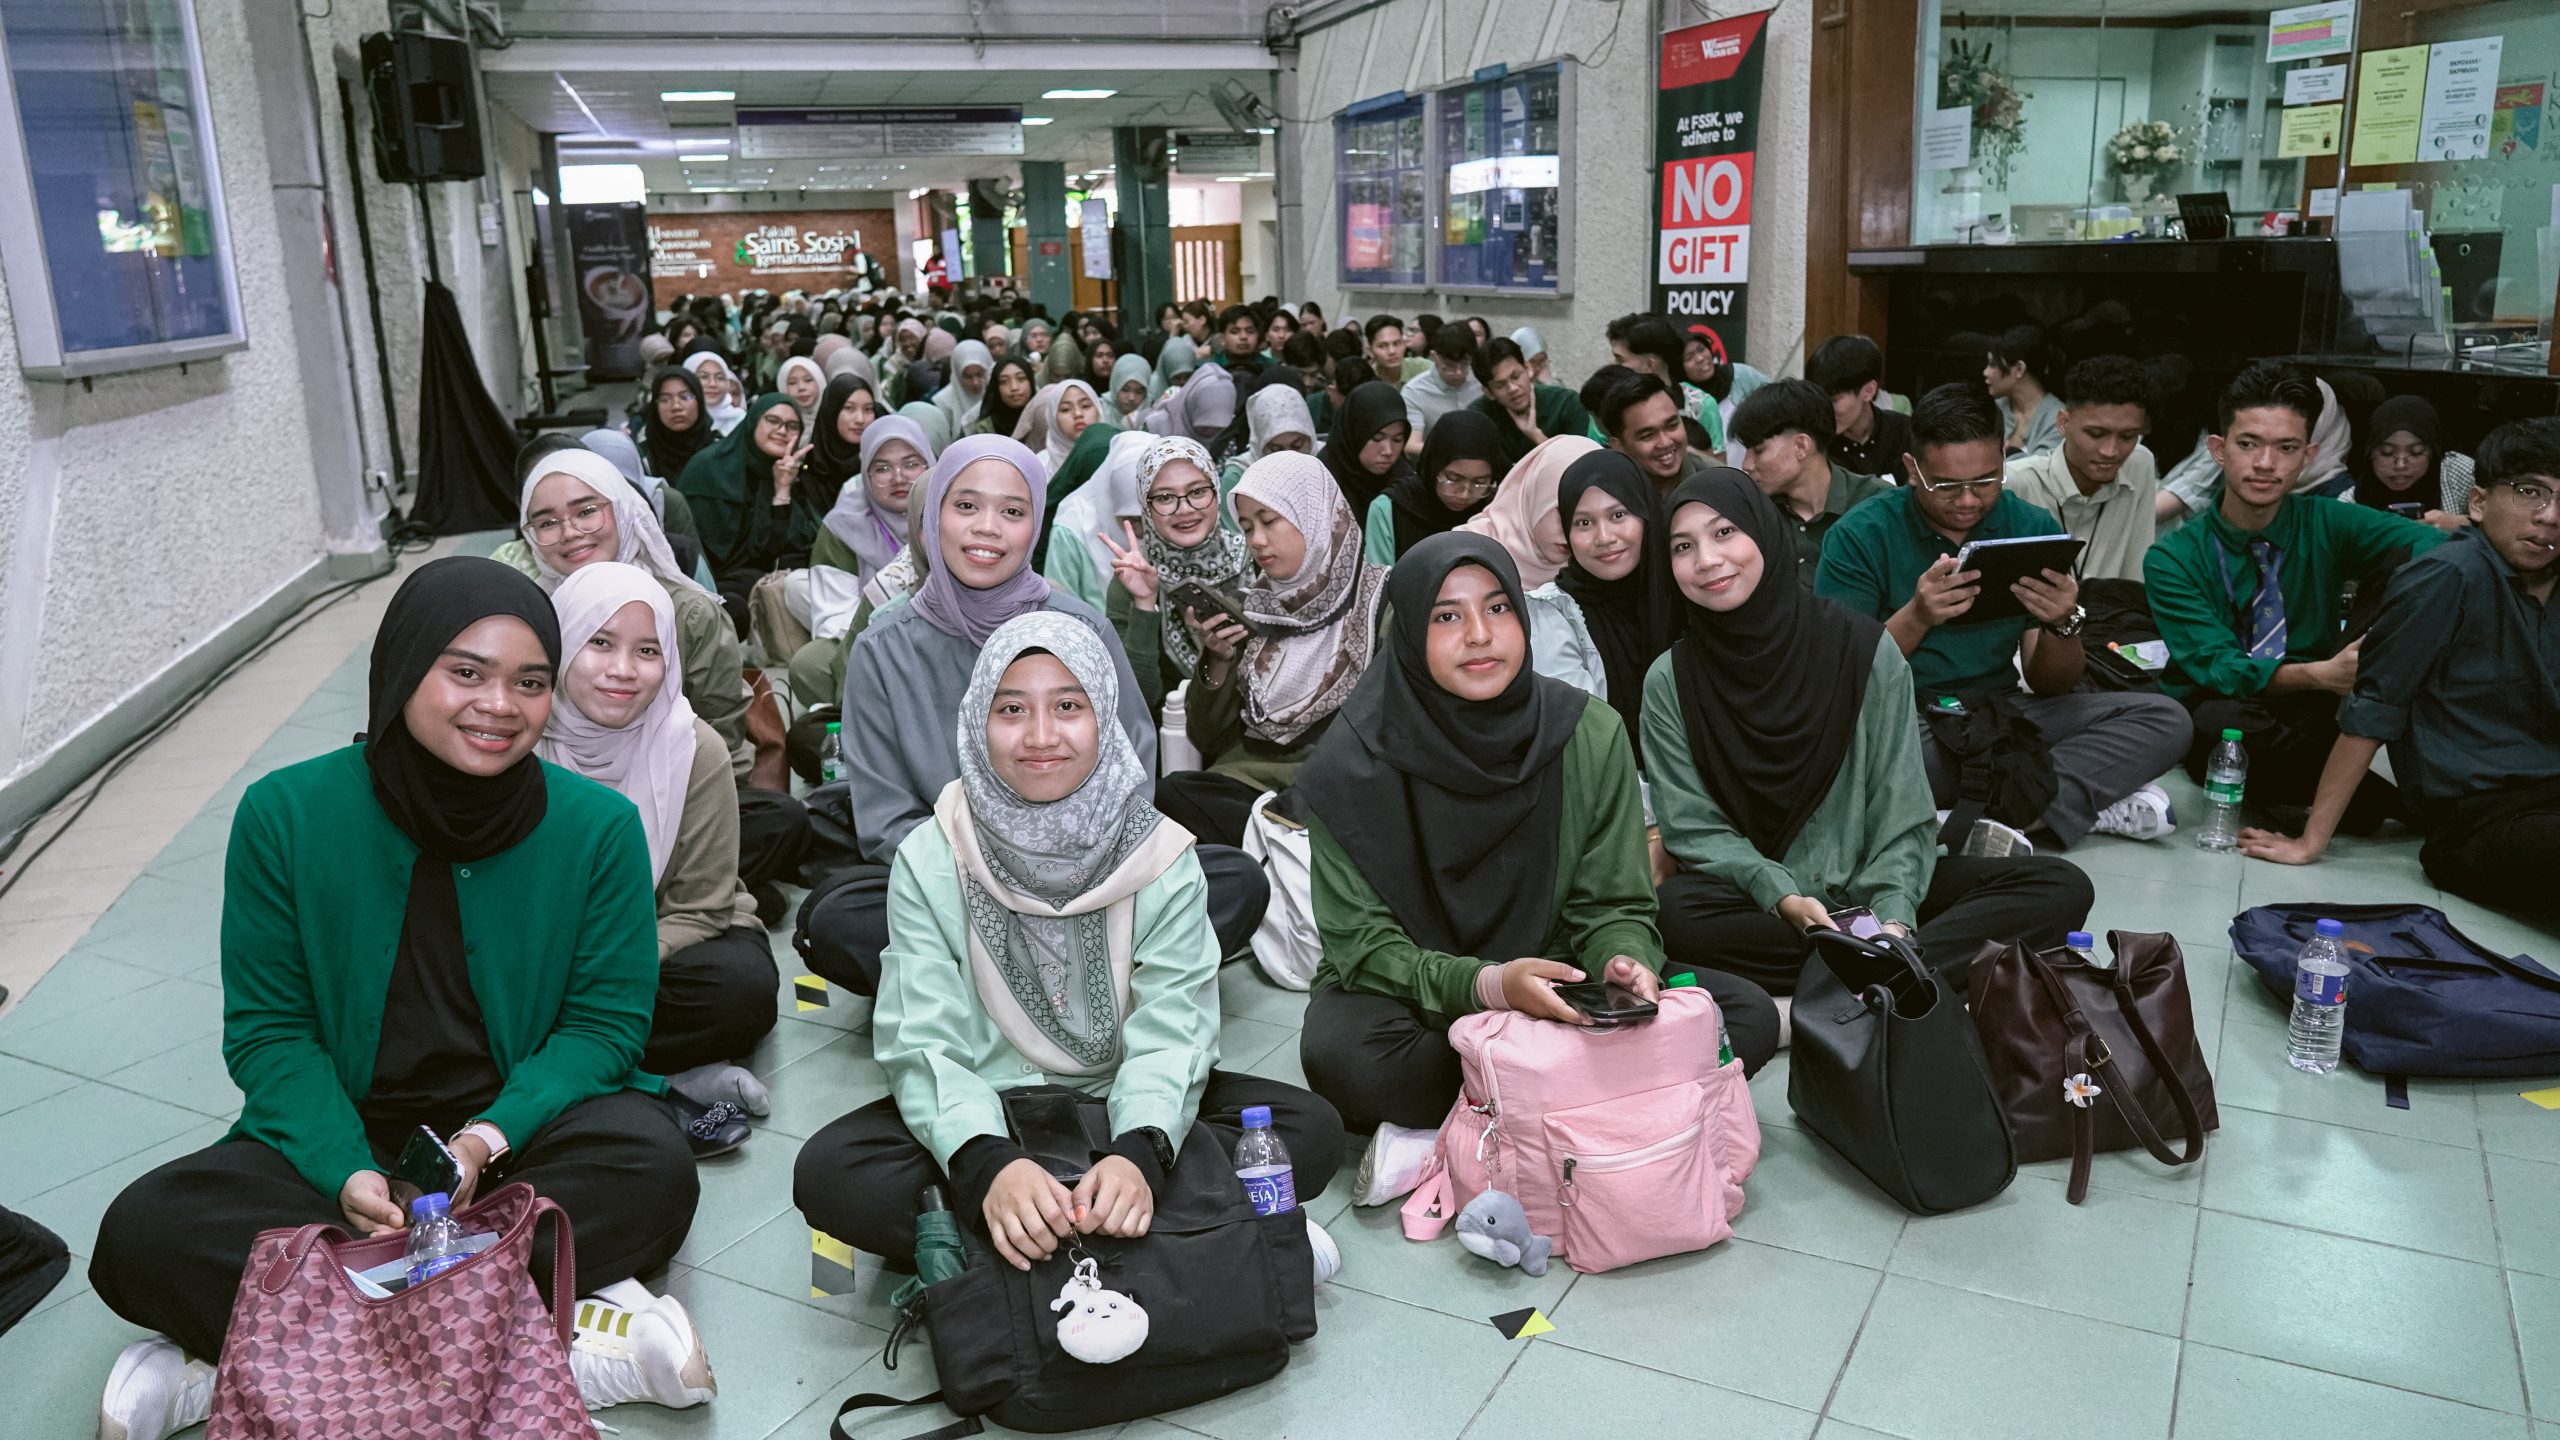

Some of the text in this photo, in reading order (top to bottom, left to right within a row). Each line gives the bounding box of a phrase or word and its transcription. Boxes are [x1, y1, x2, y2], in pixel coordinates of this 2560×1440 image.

[1677, 111, 1744, 133] At FSSK, we
[1681, 127, 1736, 147] adhere to
[1672, 160, 1743, 223] NO
[744, 232, 800, 255] Sains
[758, 224, 798, 240] Fakulti
[733, 239, 754, 266] &
[1668, 234, 1739, 275] GIFT
[1667, 290, 1735, 315] POLICY
[1248, 1189, 1273, 1204] ESA
